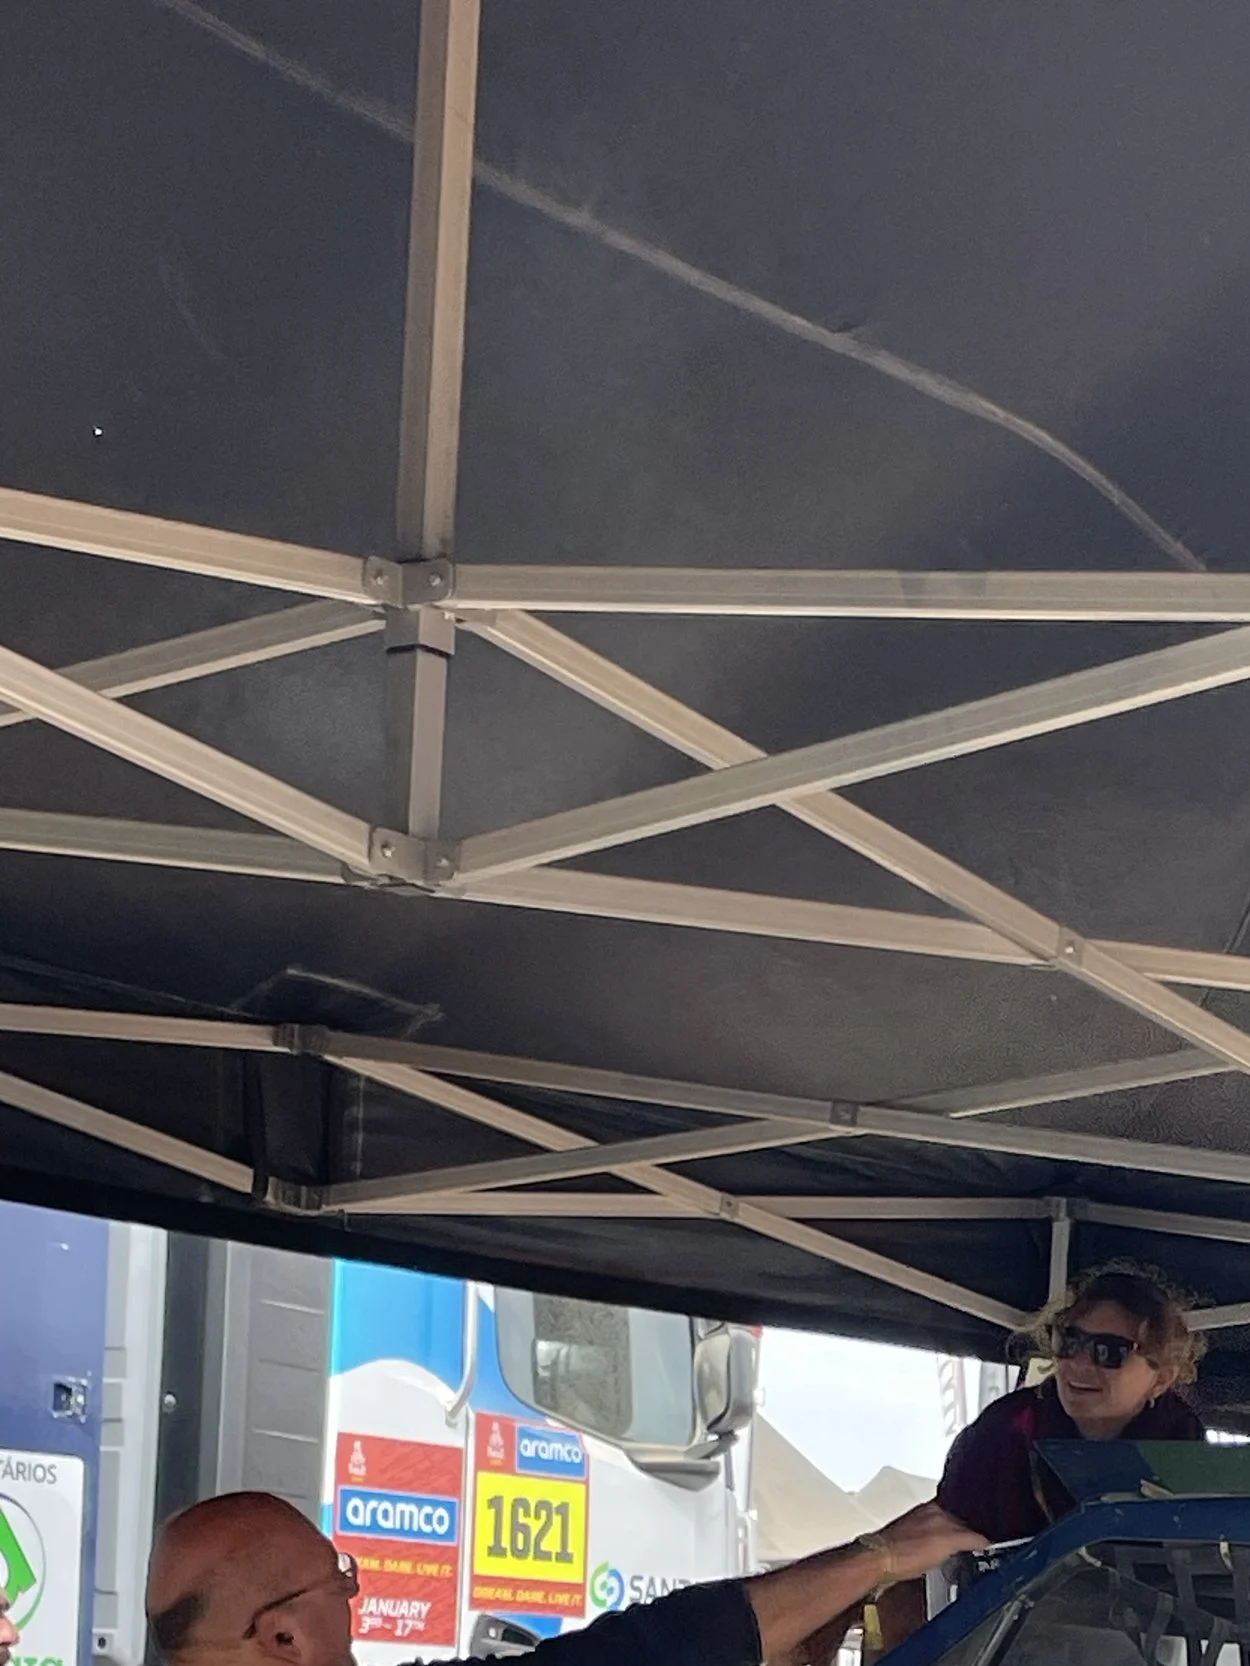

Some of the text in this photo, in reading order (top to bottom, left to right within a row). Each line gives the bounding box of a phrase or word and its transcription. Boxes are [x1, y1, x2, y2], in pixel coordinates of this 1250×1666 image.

[519, 1436, 583, 1464] aramco
[0, 1456, 58, 1485] ÁRIOS
[346, 1497, 450, 1535] aramco
[486, 1495, 574, 1564] 1621
[629, 1574, 692, 1605] SAN
[358, 1597, 432, 1619] JANUARY
